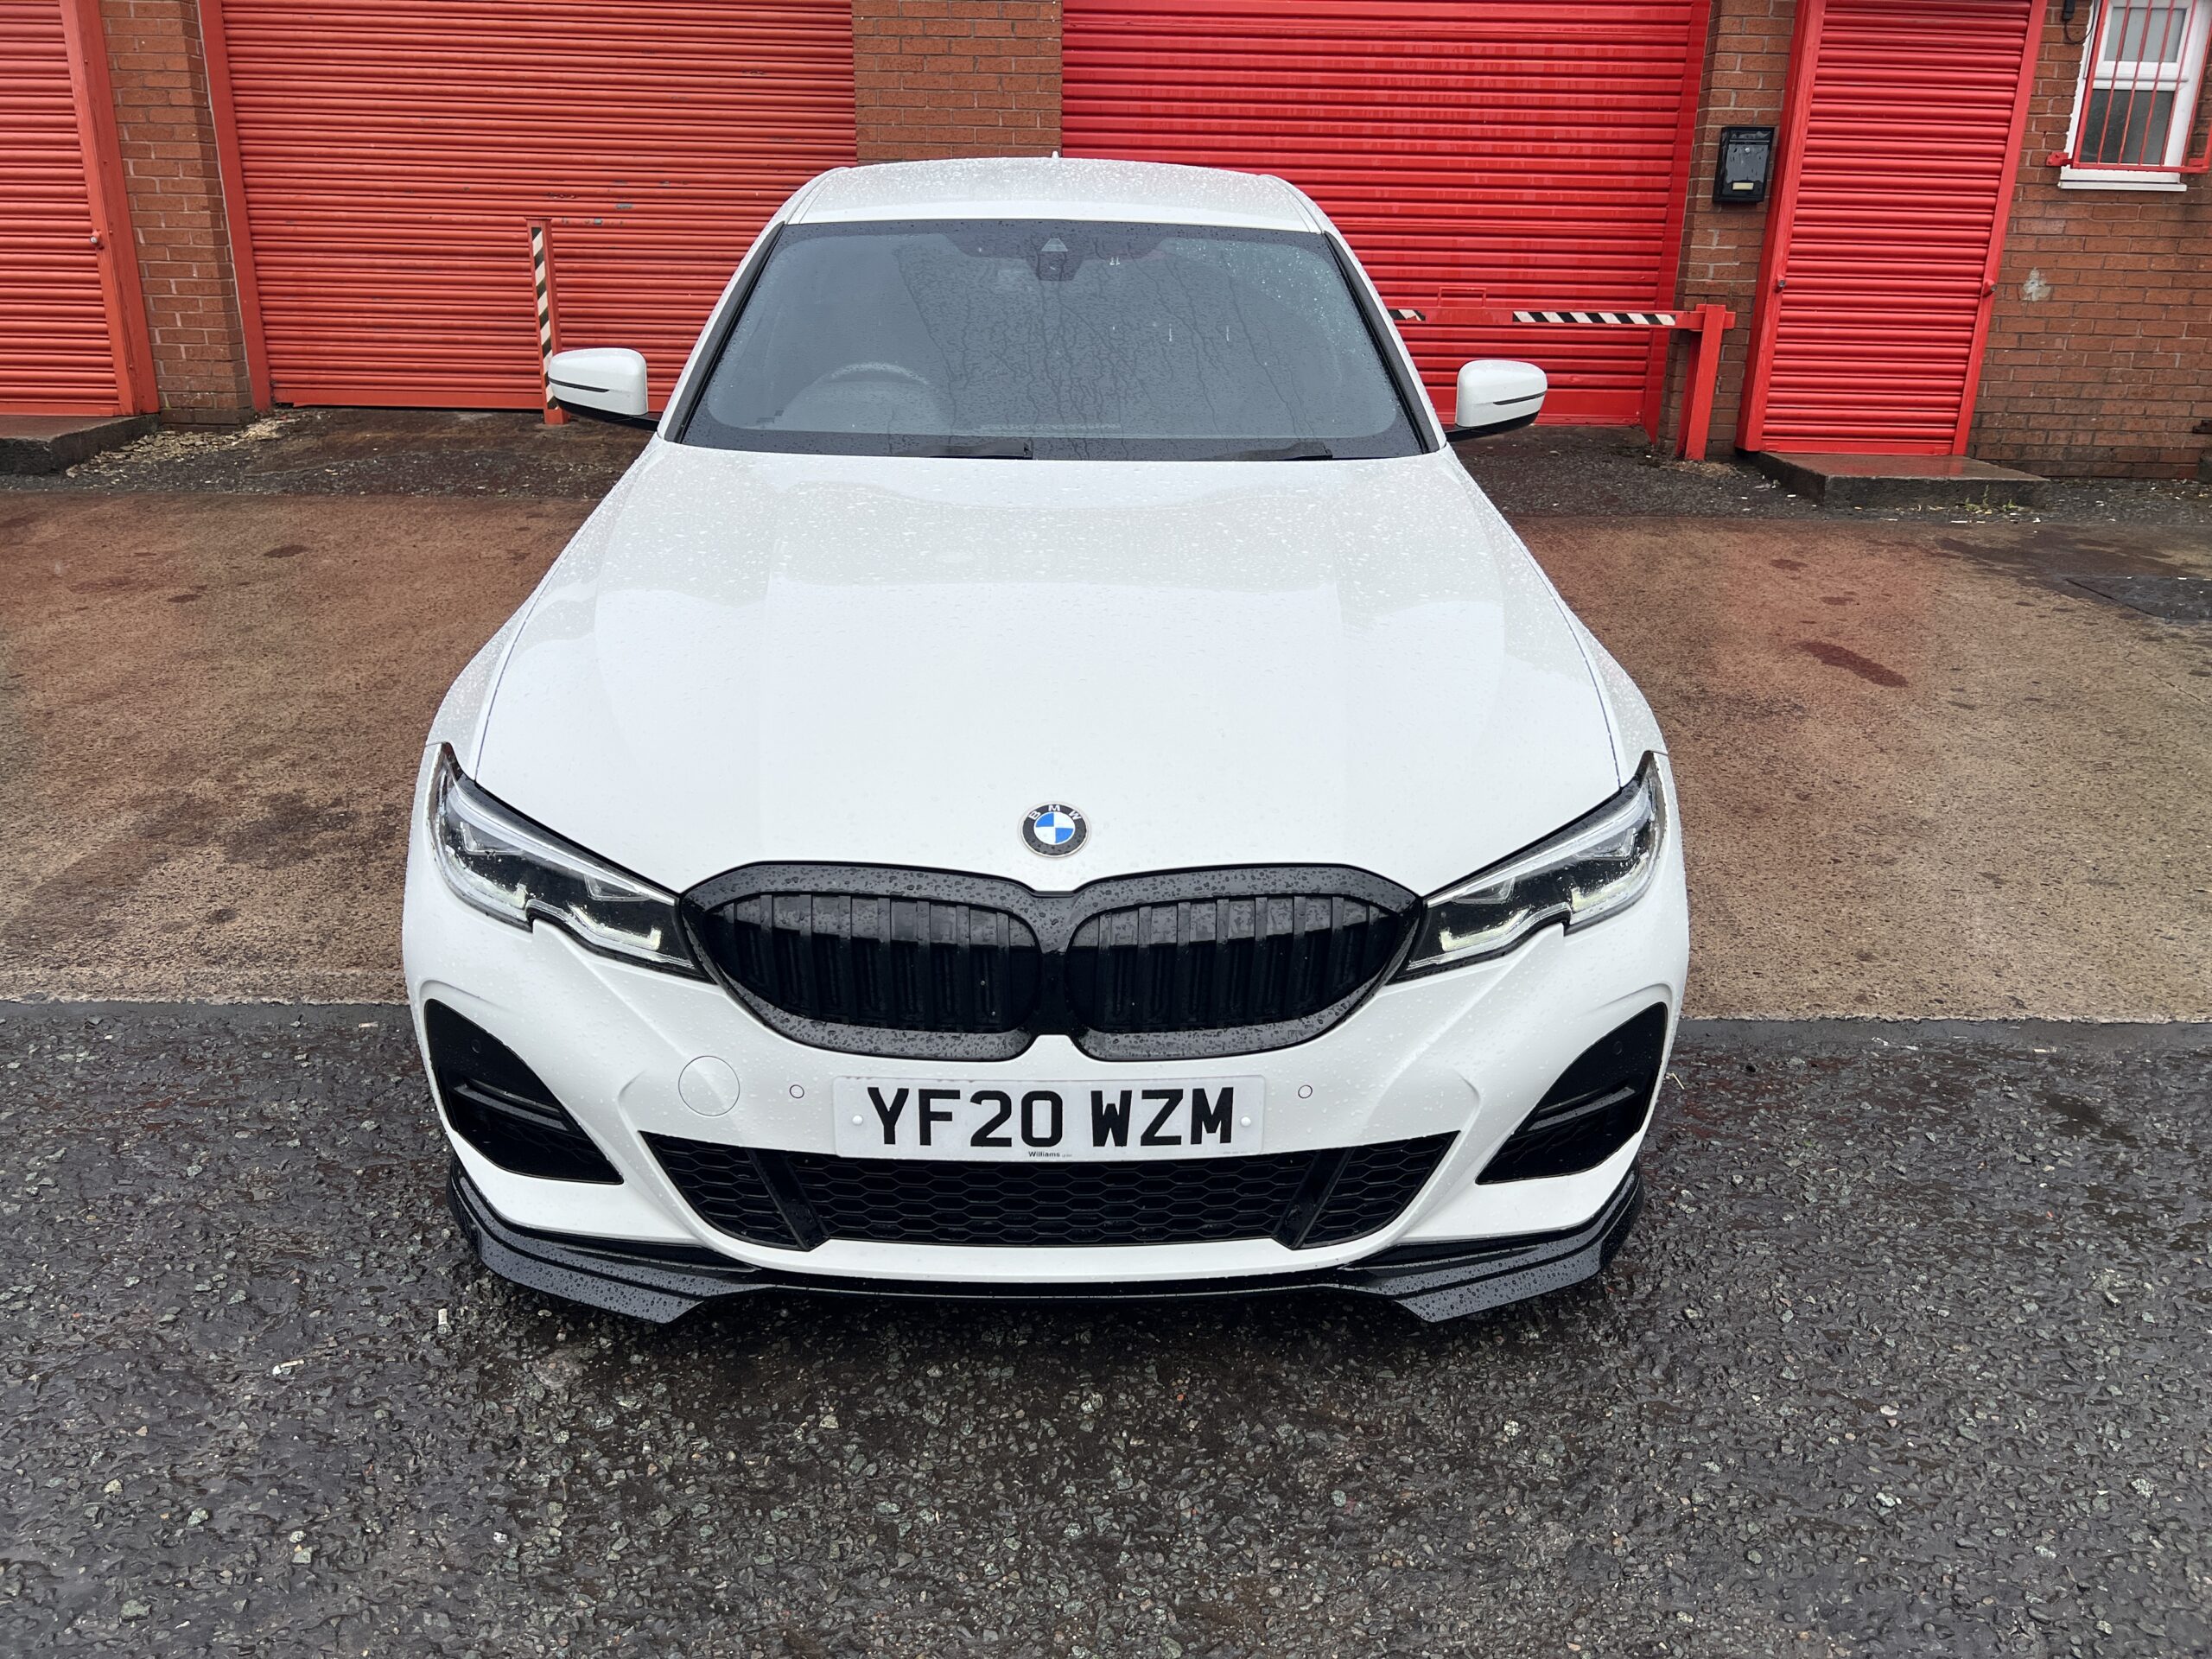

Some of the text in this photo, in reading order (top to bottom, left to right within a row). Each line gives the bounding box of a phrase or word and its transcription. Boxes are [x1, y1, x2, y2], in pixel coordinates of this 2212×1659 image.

[1028, 804, 1082, 820] BMW
[867, 1087, 1234, 1147] YF20 WZM
